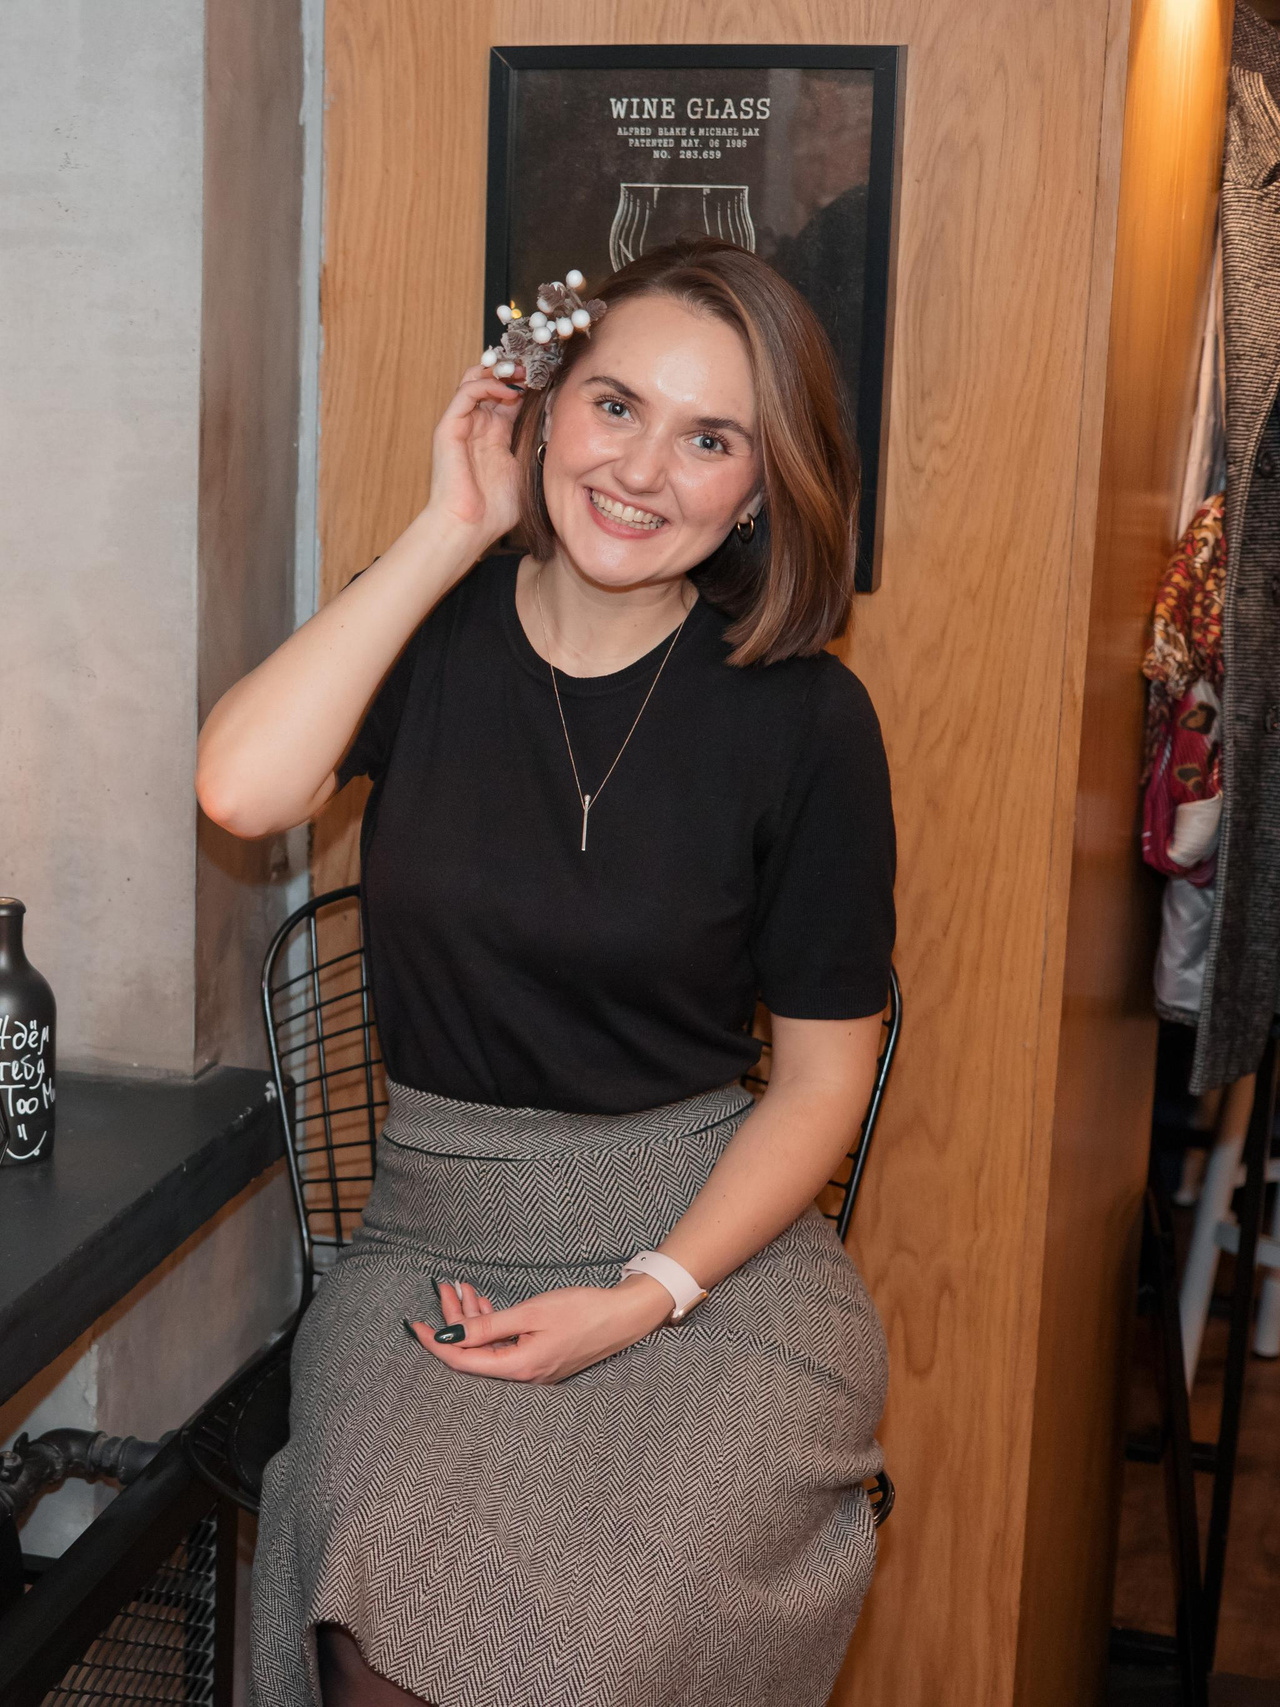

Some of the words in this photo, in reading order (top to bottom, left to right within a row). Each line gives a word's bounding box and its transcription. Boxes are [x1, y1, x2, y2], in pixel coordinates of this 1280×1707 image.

[609, 97, 675, 119] WINE
[686, 97, 771, 120] GLASS
[616, 127, 652, 137] ALFRED
[658, 127, 688, 137] BLAKE
[689, 127, 696, 137] &
[698, 127, 740, 137] MICHAEL
[742, 127, 760, 137] LAX
[628, 138, 675, 148] PATENTED
[708, 138, 721, 148] 06
[652, 149, 672, 160] NO.
